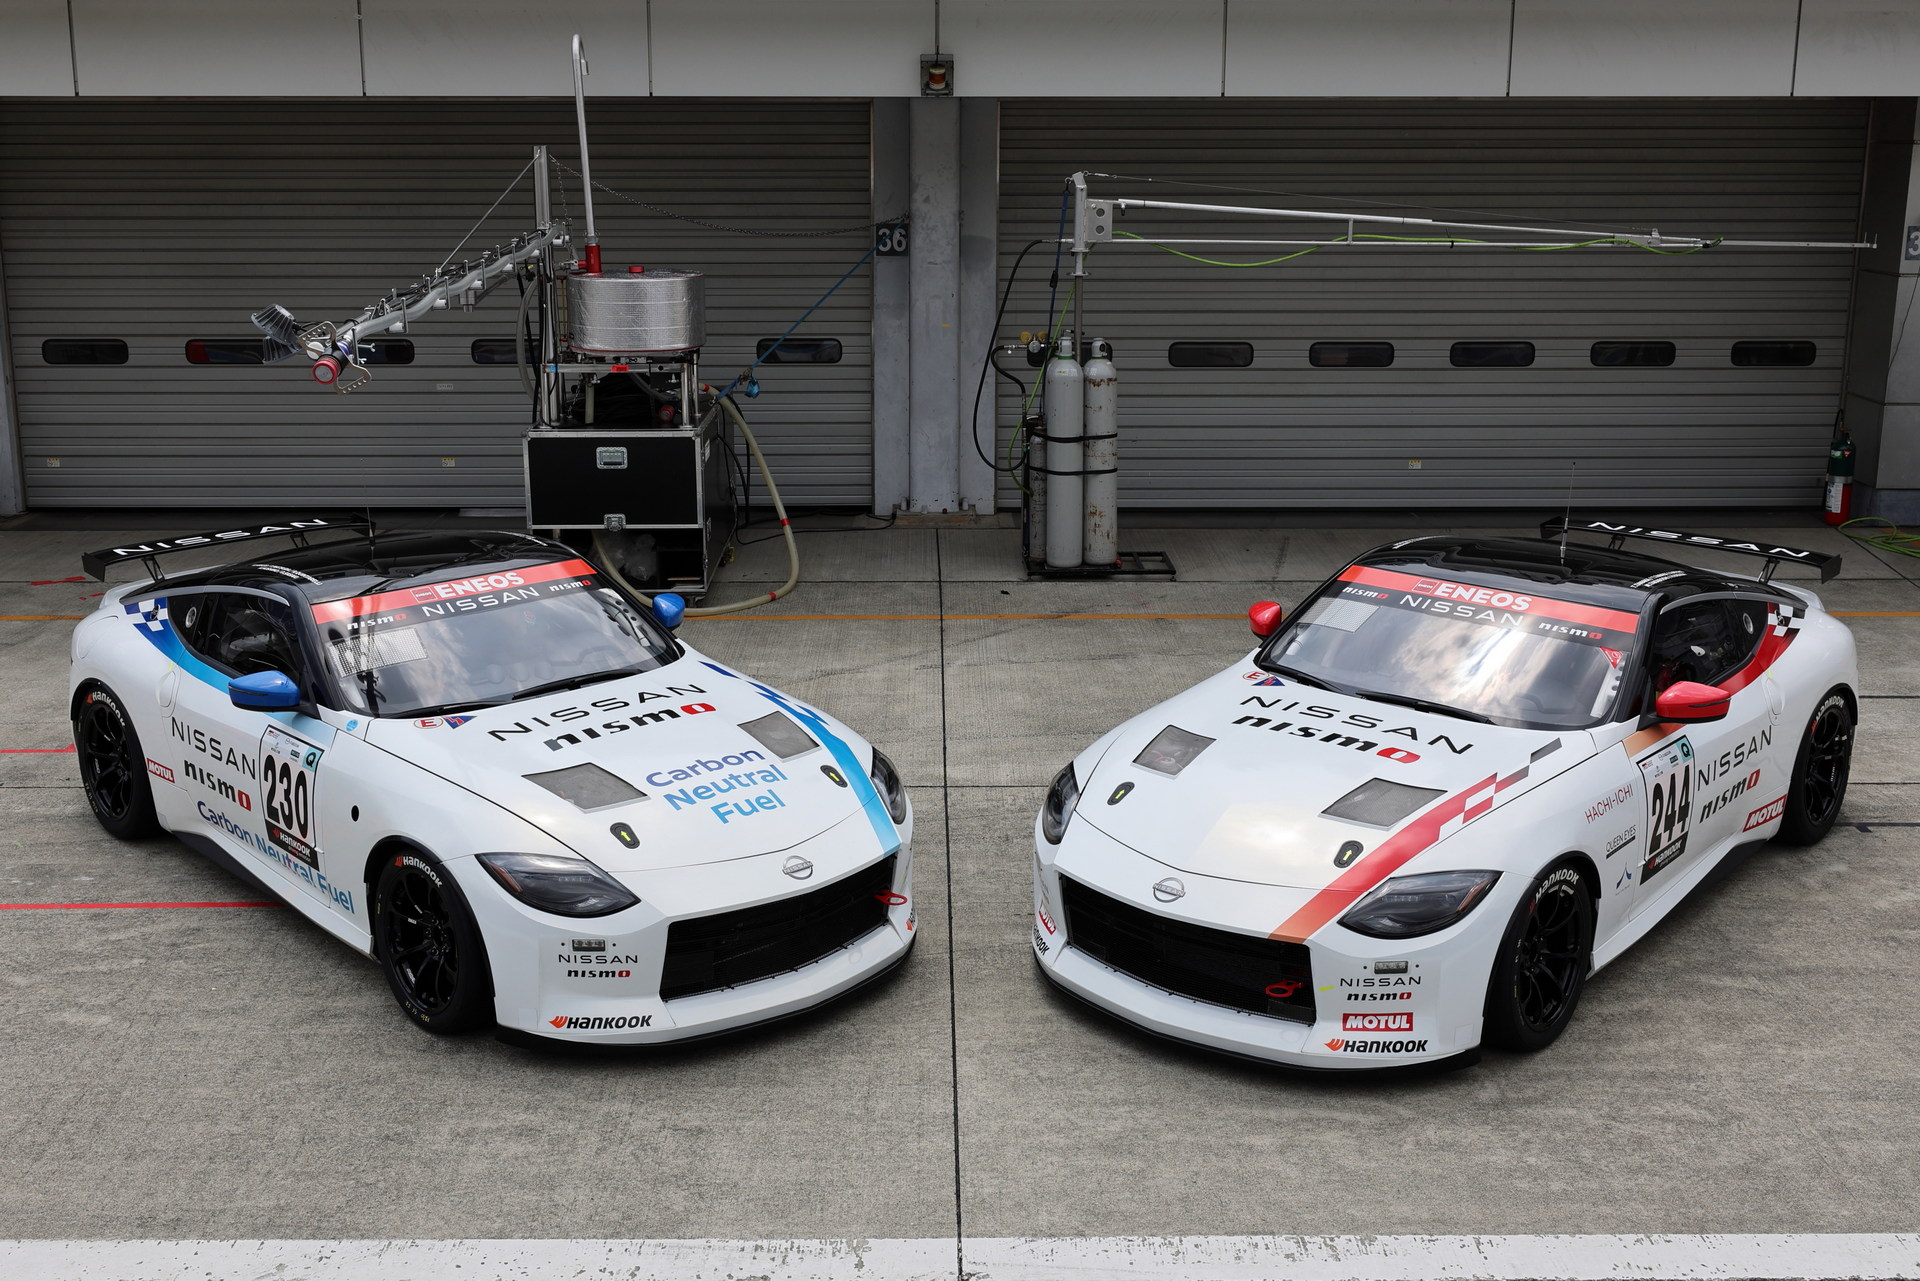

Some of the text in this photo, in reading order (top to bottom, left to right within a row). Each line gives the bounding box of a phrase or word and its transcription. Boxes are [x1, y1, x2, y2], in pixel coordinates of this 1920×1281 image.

[878, 228, 907, 252] 36
[112, 518, 328, 556] NISSAN
[1587, 522, 1810, 558] NISSAN
[421, 586, 540, 617] NISSAN
[433, 572, 525, 599] ENEOS
[1433, 583, 1532, 611] ENEOS
[1399, 594, 1524, 626] NISSAN
[488, 684, 706, 742] NISSAN
[1240, 695, 1474, 755] NISSAN
[172, 716, 256, 780] NISSAN
[305, 751, 317, 768] Q
[1681, 742, 1691, 758] Q
[1697, 725, 1772, 792] NISSAN
[149, 759, 174, 781] MOTUL
[646, 747, 765, 788] Carbon
[263, 754, 308, 839] 230
[662, 764, 788, 811] Neutral
[1584, 783, 1634, 825] HACHI-ICHI
[709, 790, 786, 824] Fuel
[1648, 763, 1691, 857] 244
[1746, 798, 1786, 830] MOTUL
[1605, 824, 1637, 853] QUEEN EYES
[197, 800, 355, 915] Carbon Neutral Fuel
[558, 954, 639, 965] NISSAN
[1339, 976, 1422, 987] NISSAN
[1345, 1014, 1411, 1030] MOTUL
